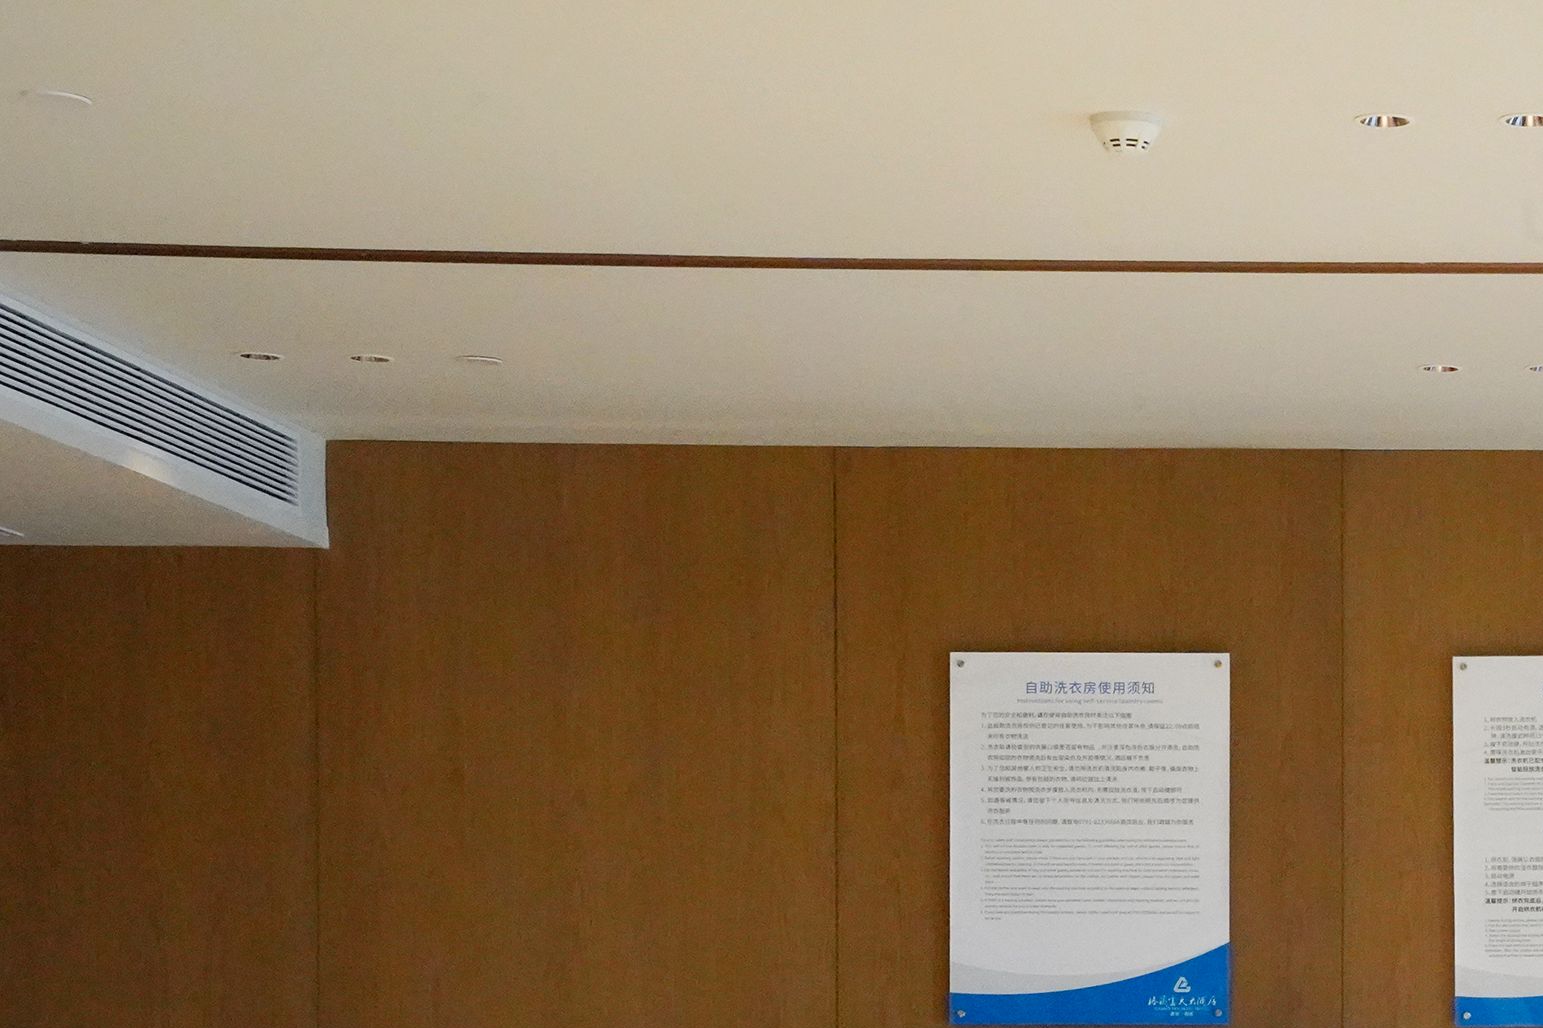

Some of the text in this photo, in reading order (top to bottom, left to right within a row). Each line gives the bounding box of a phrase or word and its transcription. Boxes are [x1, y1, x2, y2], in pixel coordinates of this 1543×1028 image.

[1025, 681, 1155, 695] 自助洗衣房使用须知
